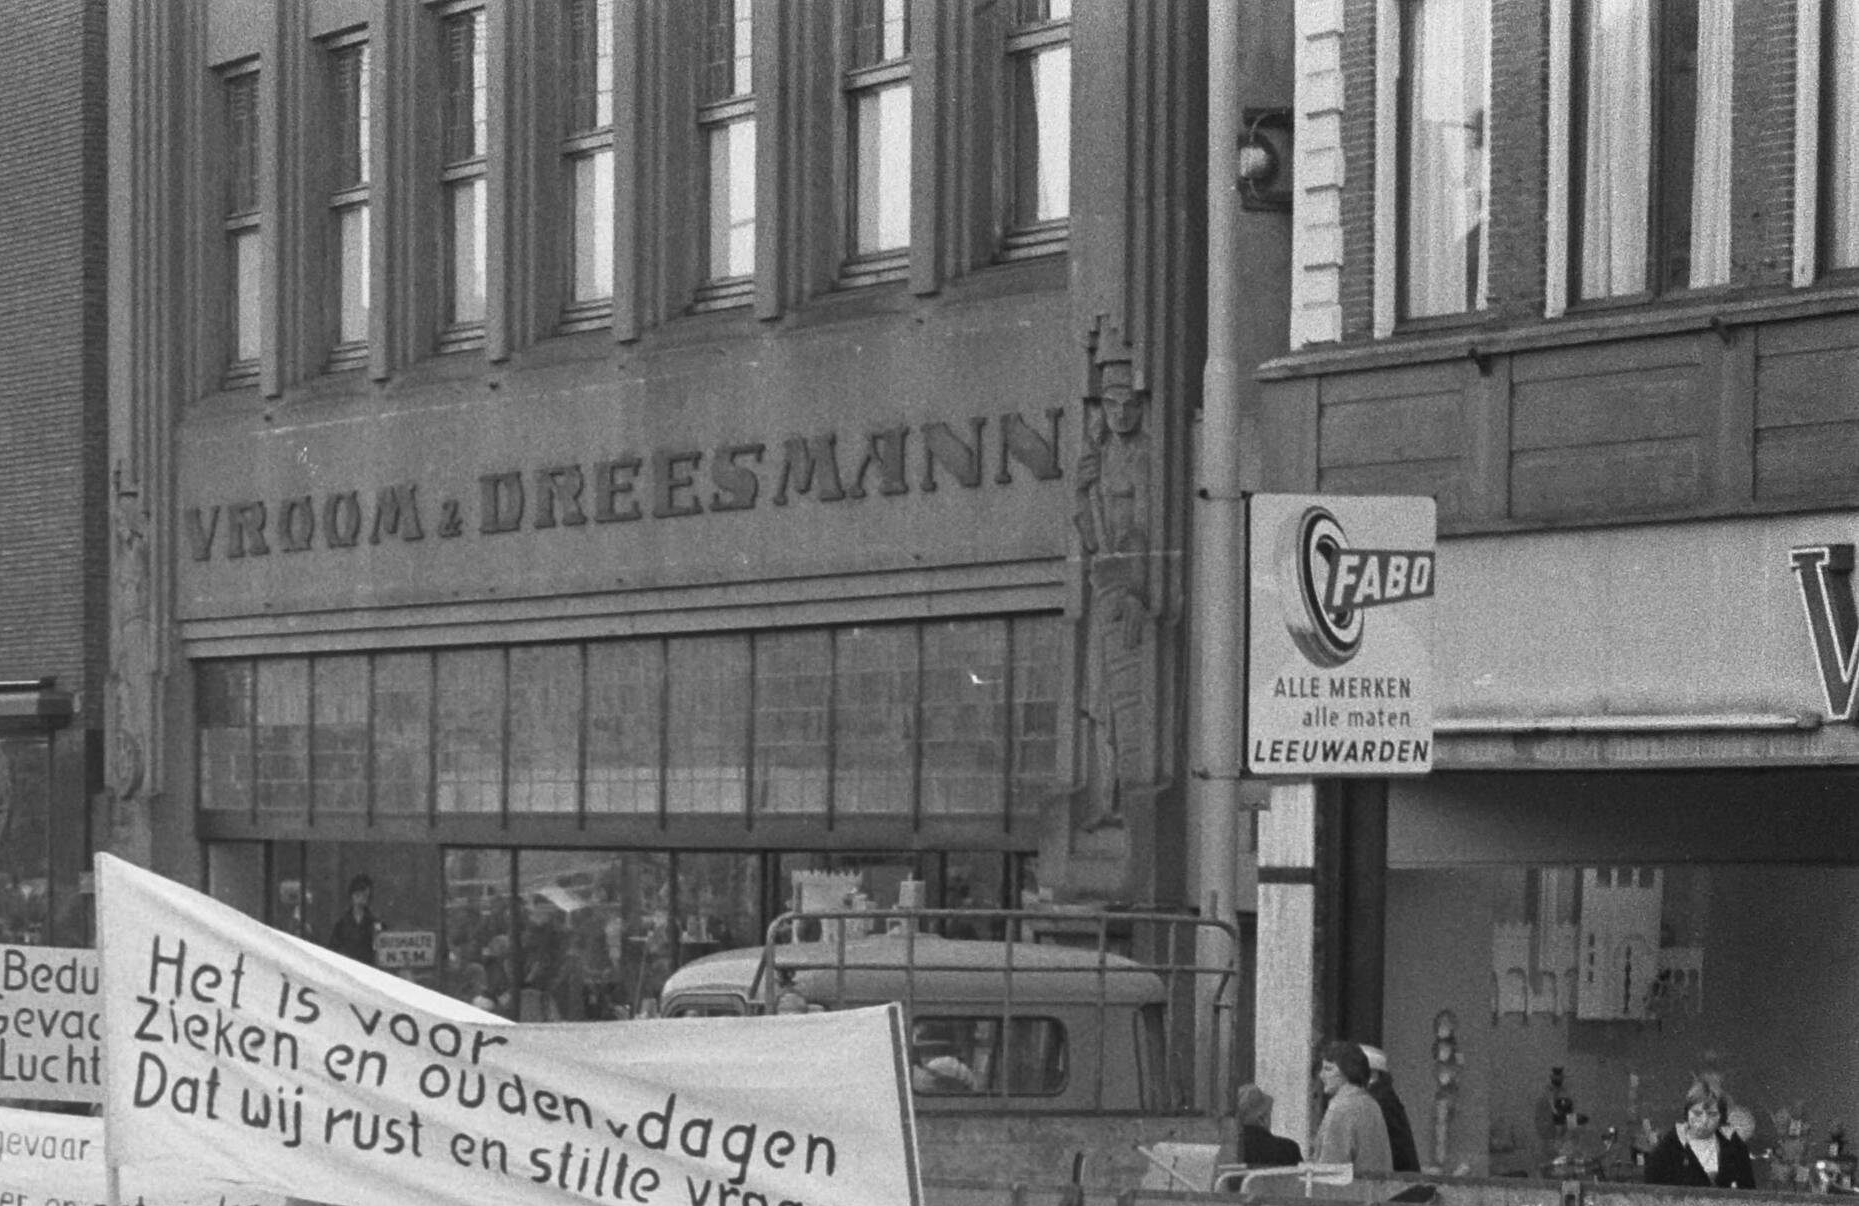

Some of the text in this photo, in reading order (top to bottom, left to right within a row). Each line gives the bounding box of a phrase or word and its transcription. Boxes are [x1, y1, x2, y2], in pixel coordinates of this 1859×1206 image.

[184, 407, 1065, 562] VROOM & DREESMANN
[1332, 554, 1432, 606] FABO
[1273, 676, 1412, 699] ALLE MERKEN
[1301, 706, 1412, 728] alle maten
[1253, 739, 1430, 763] LEEUWARDEN
[148, 935, 509, 1065] Het is voor
[133, 1051, 220, 1120] Dat
[241, 1086, 304, 1149] wij
[324, 1106, 424, 1158] rust
[450, 1132, 508, 1175] en
[324, 1044, 388, 1087] en
[418, 1063, 593, 1129] ouden
[636, 1092, 837, 1185] dagen
